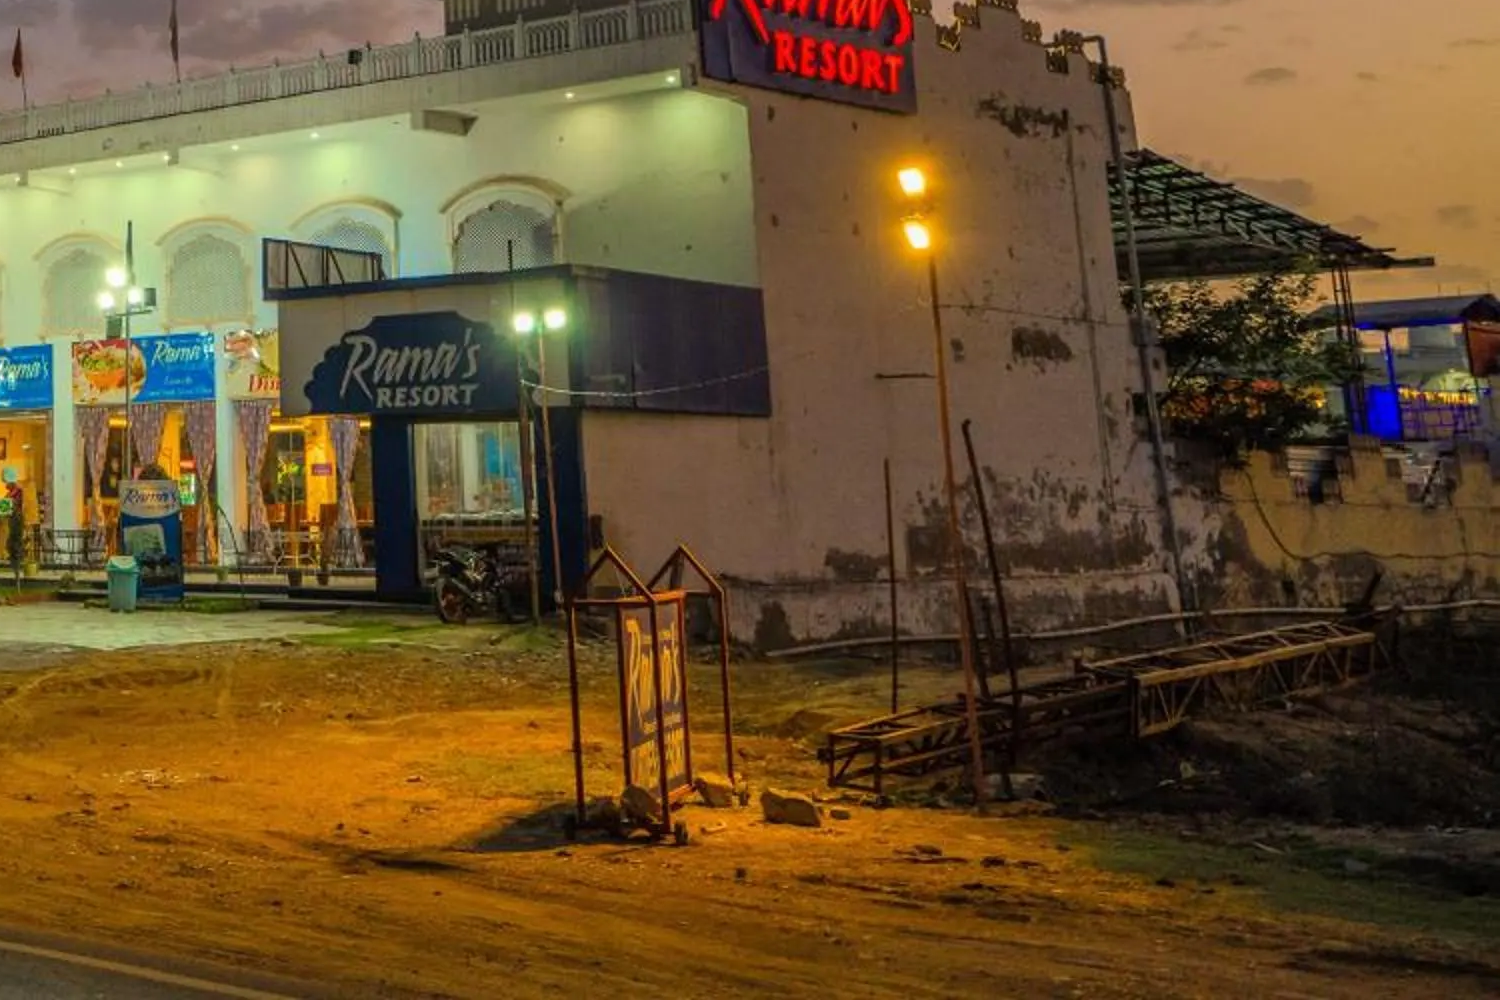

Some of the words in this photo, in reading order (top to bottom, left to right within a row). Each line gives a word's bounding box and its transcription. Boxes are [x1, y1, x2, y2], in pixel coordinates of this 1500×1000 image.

[773, 28, 905, 94] RESORT
[339, 327, 481, 400] Rama's
[376, 383, 480, 409] RESORT
